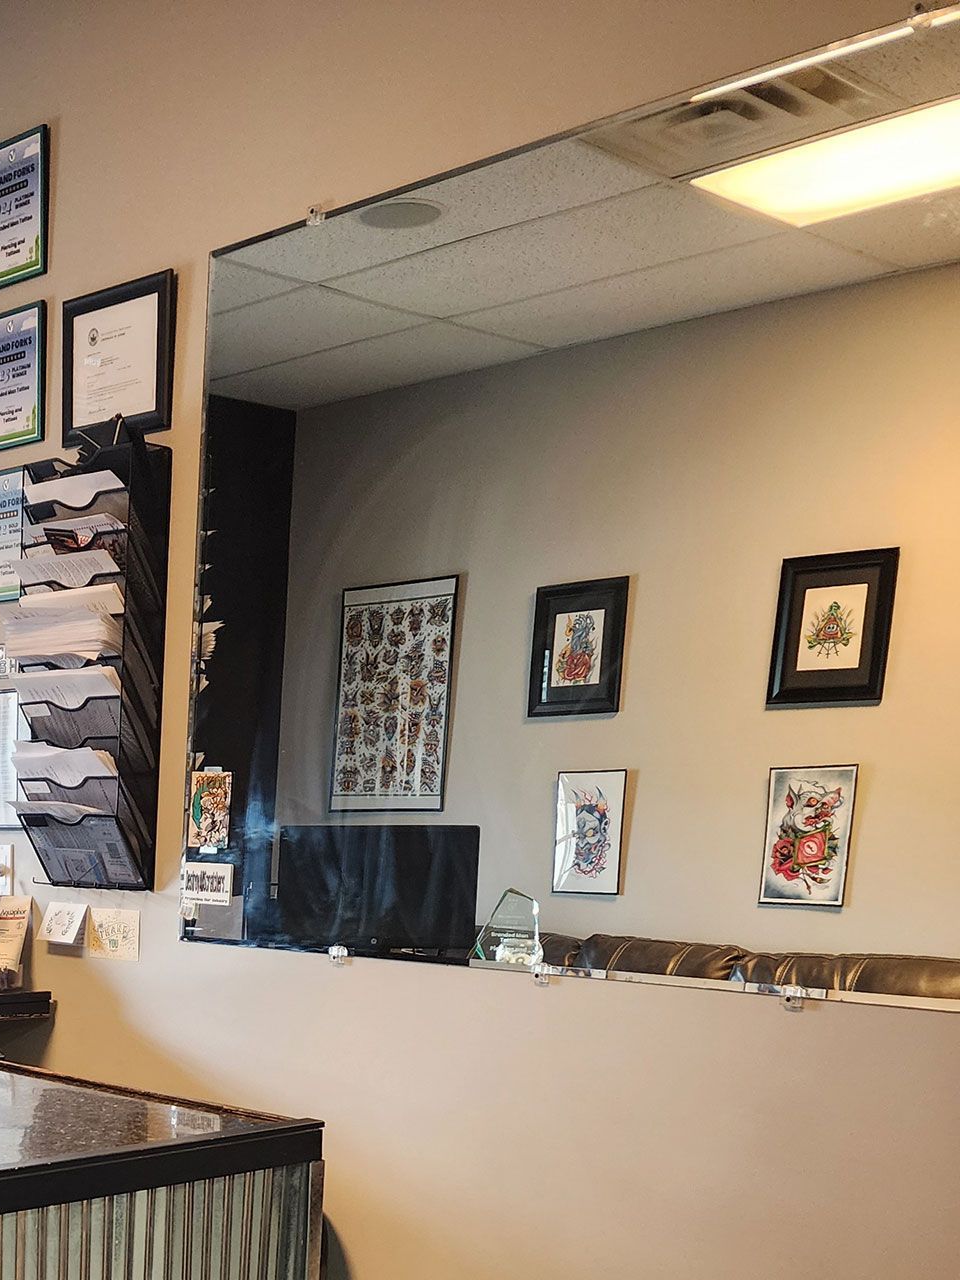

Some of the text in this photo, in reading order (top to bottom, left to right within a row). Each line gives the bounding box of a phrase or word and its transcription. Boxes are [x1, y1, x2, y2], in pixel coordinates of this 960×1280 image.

[14, 163, 35, 179] FORKS
[1, 242, 17, 251] Piercing
[12, 336, 32, 350] FORKS
[0, 409, 14, 417] Piercing
[0, 908, 26, 917] Aquaphor
[100, 924, 127, 938] THANK
[109, 939, 118, 948] YOU
